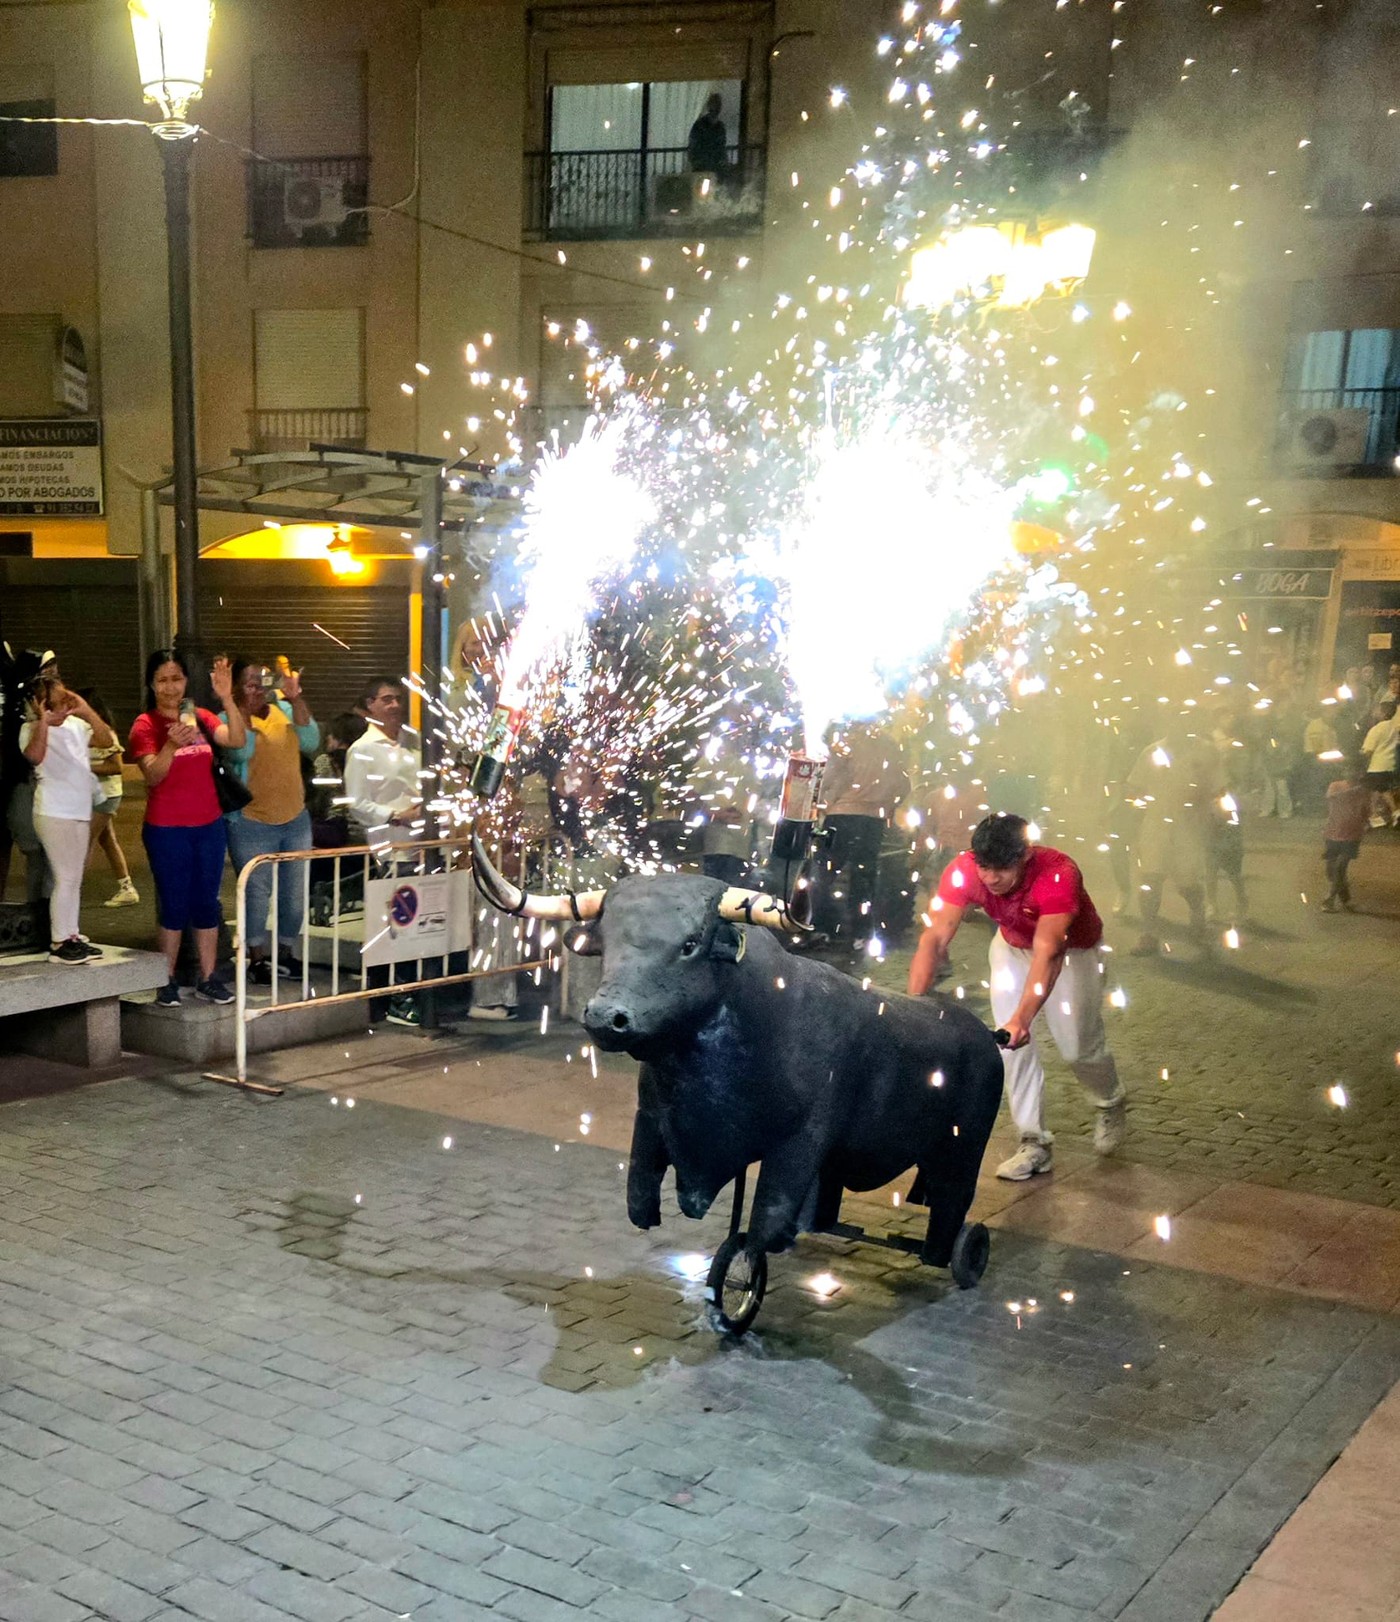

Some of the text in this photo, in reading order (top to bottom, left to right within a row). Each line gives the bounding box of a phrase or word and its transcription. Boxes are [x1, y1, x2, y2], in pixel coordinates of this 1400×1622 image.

[23, 450, 74, 460] EMBARGOS
[27, 463, 65, 472] DEUDAS
[20, 475, 70, 485] HIPOTECAS
[8, 487, 31, 498] POR
[33, 486, 95, 498] ABOGADOS
[1256, 572, 1311, 594] BOGA
